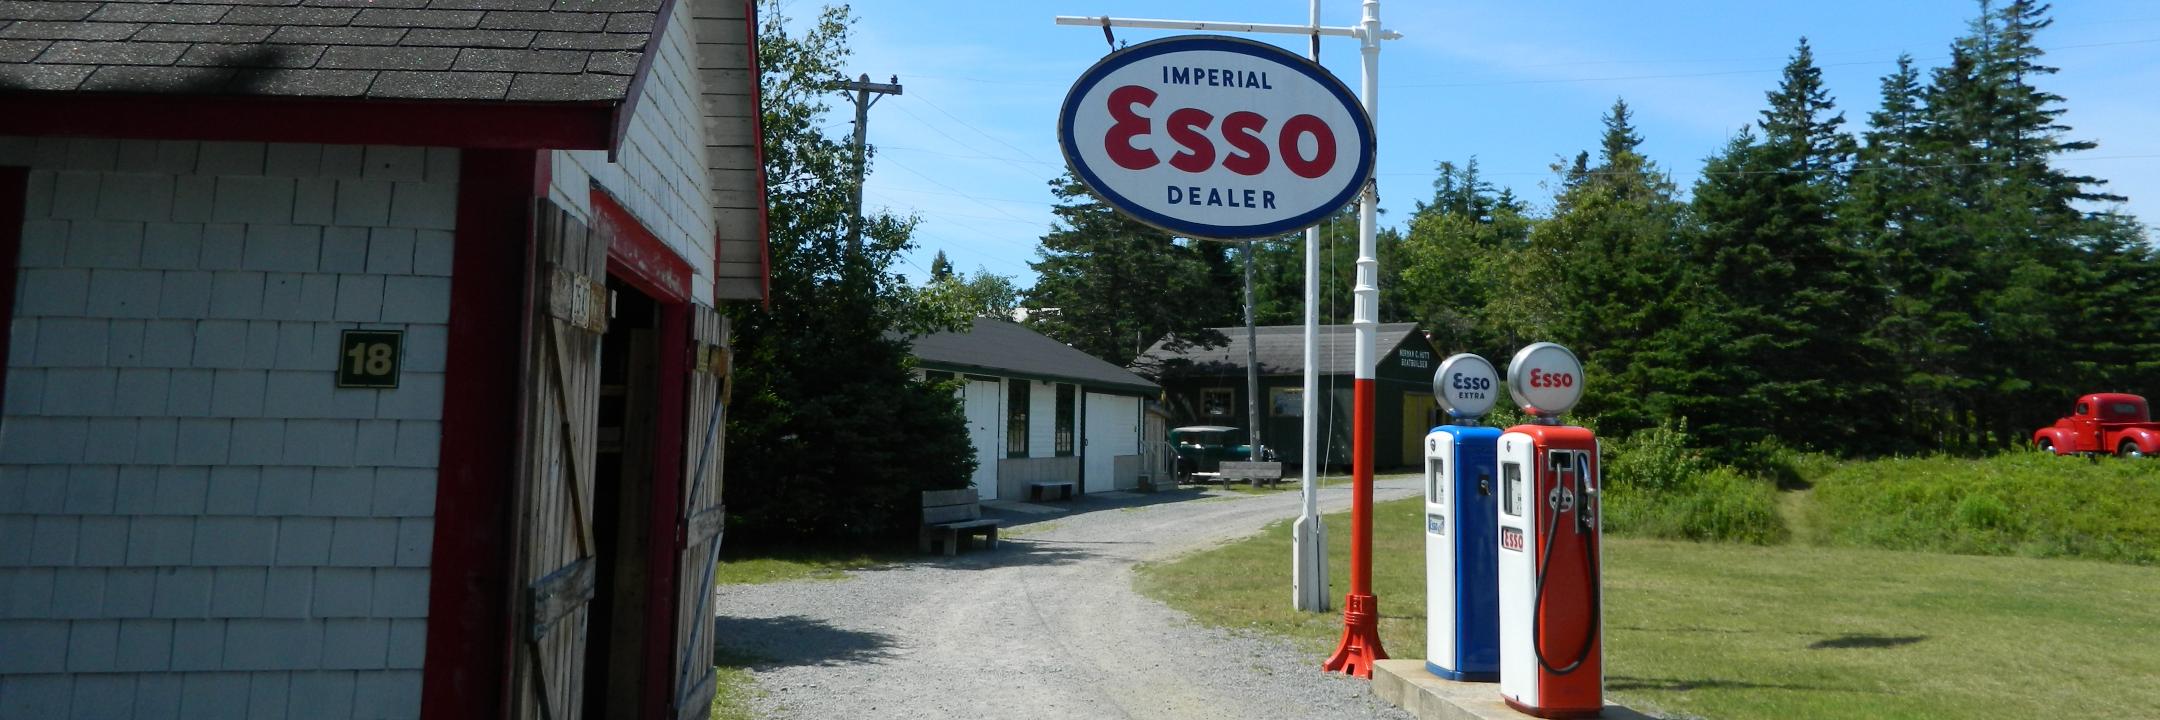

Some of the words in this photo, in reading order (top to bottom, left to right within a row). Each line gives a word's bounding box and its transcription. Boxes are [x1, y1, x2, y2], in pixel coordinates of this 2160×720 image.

[1163, 66, 1272, 89] IMPERIAL
[1104, 85, 1337, 179] Esso
[1167, 185, 1276, 209] DEALER
[347, 342, 392, 376] 18
[1453, 372, 1490, 390] Esso
[1530, 367, 1573, 388] Esso
[1458, 391, 1485, 400] EXTRA
